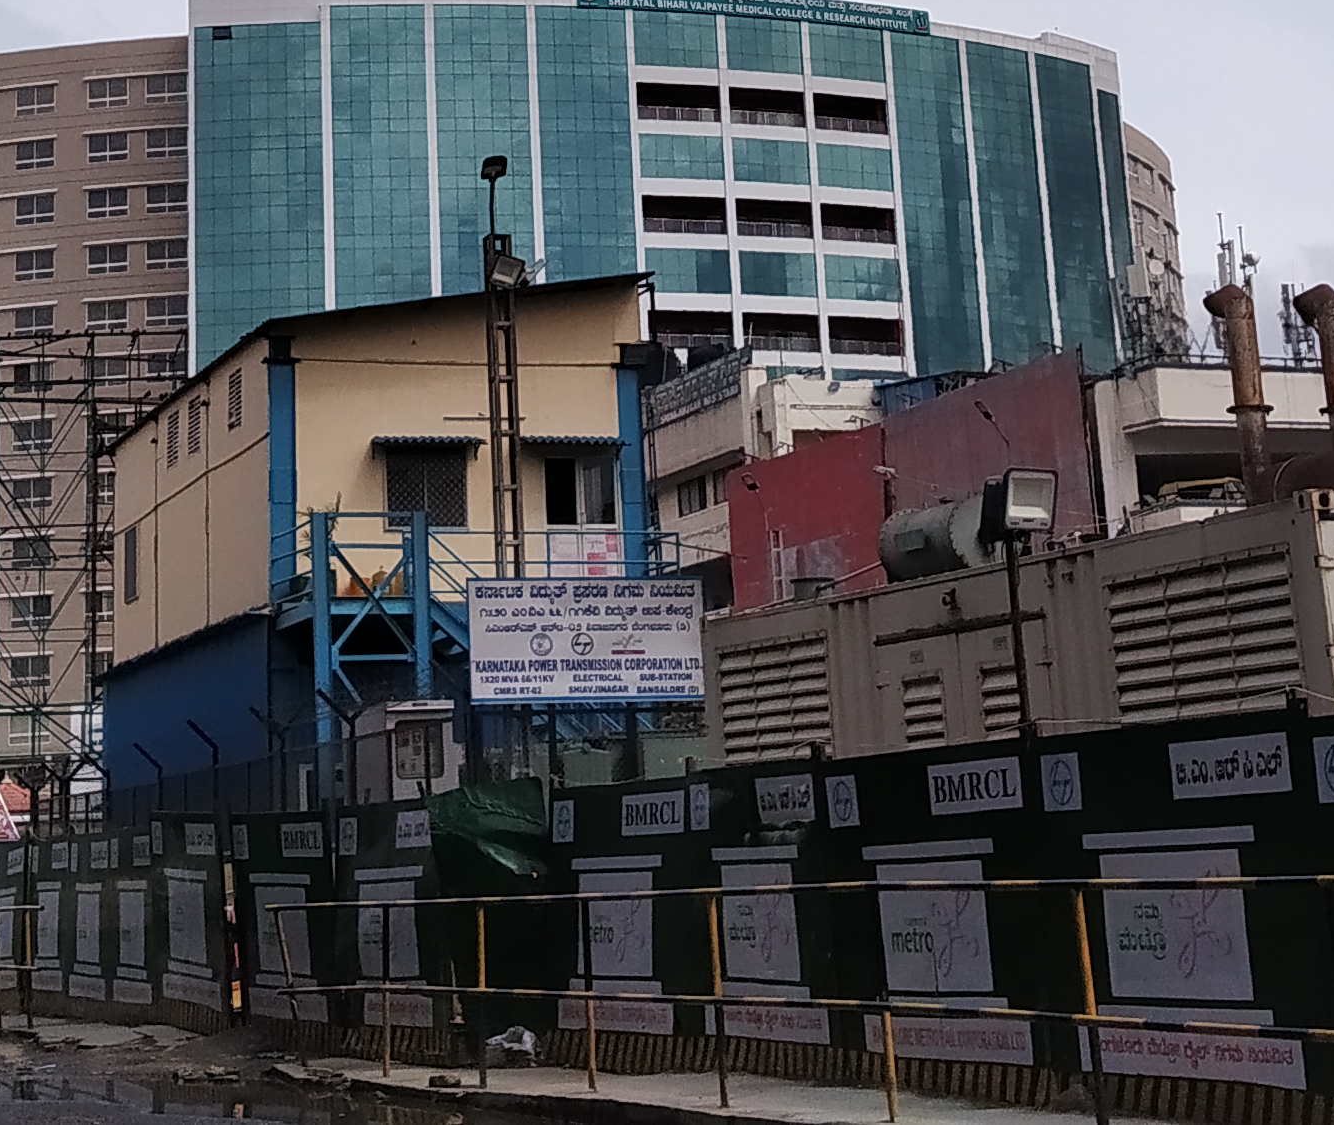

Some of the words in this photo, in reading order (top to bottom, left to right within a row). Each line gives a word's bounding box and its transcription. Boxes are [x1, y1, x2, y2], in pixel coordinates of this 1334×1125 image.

[657, 0, 688, 10] BIHARI
[690, 1, 733, 13] VAJPAYEE
[736, 4, 774, 16] MEDICAL
[775, 8, 813, 20] COLLEGE
[816, 11, 821, 20] &
[824, 12, 866, 25] RESEARCH
[868, 17, 908, 30] INSTITUTE
[475, 583, 524, 599] ಕರ್ನಾಟಕ
[614, 583, 644, 598] ನಿಗಮ
[650, 582, 695, 597] ನಿಯಮಿತ
[475, 660, 526, 673] KARNATAKA
[528, 659, 558, 672] POWER
[560, 658, 622, 672] TRANSMISSION
[624, 658, 682, 671] CORPORATION
[480, 675, 500, 684] 1X20
[502, 675, 519, 683] MVA
[572, 674, 623, 682] ELECTRICAL
[639, 673, 692, 681] SUB-STATION
[493, 686, 517, 695] CMRS
[637, 686, 685, 694] BANGALORE
[688, 685, 699, 695] (D)
[932, 767, 1016, 804] BMRCL
[625, 800, 680, 826] BMRCL
[282, 829, 321, 851] BMRCL
[1134, 903, 1165, 928] ನಮ್ಮ
[585, 924, 615, 945] etro
[891, 928, 934, 953] metro
